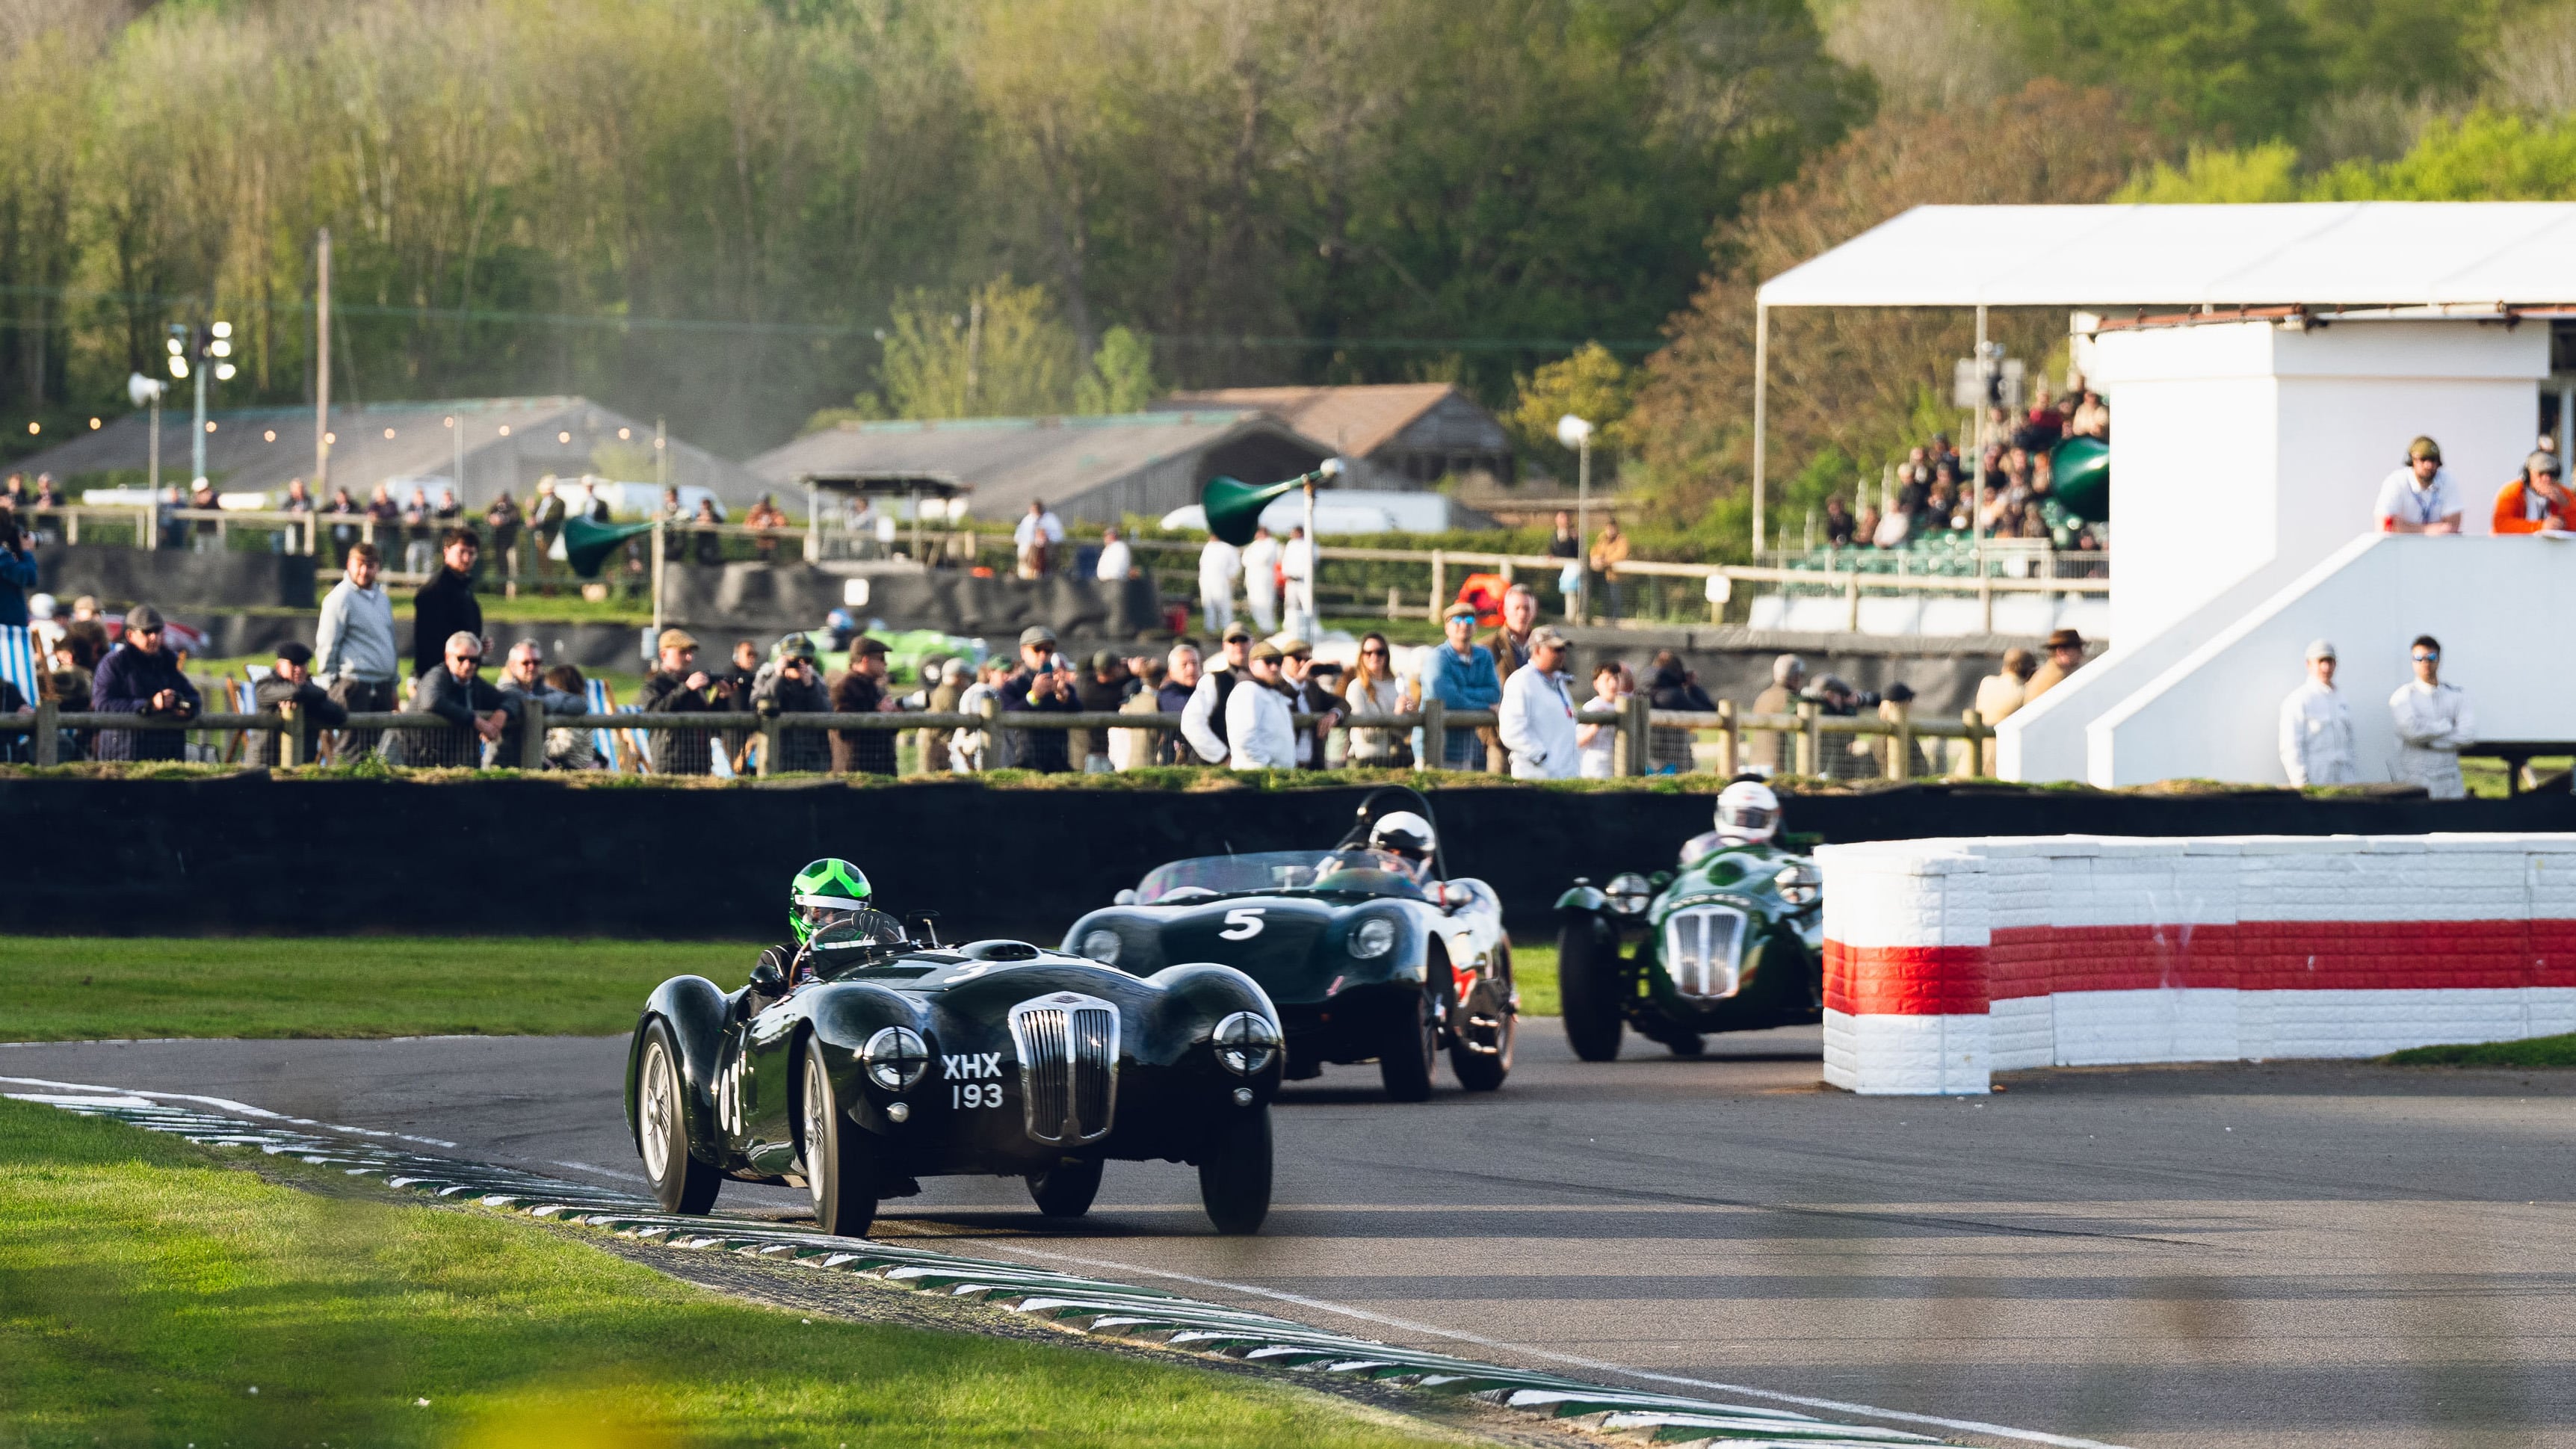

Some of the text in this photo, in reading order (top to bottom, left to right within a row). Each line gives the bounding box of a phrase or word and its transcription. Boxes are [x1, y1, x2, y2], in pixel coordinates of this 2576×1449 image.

[1218, 908, 1266, 941] 5
[942, 1052, 1002, 1079] XHX
[953, 1084, 1004, 1110] 193
